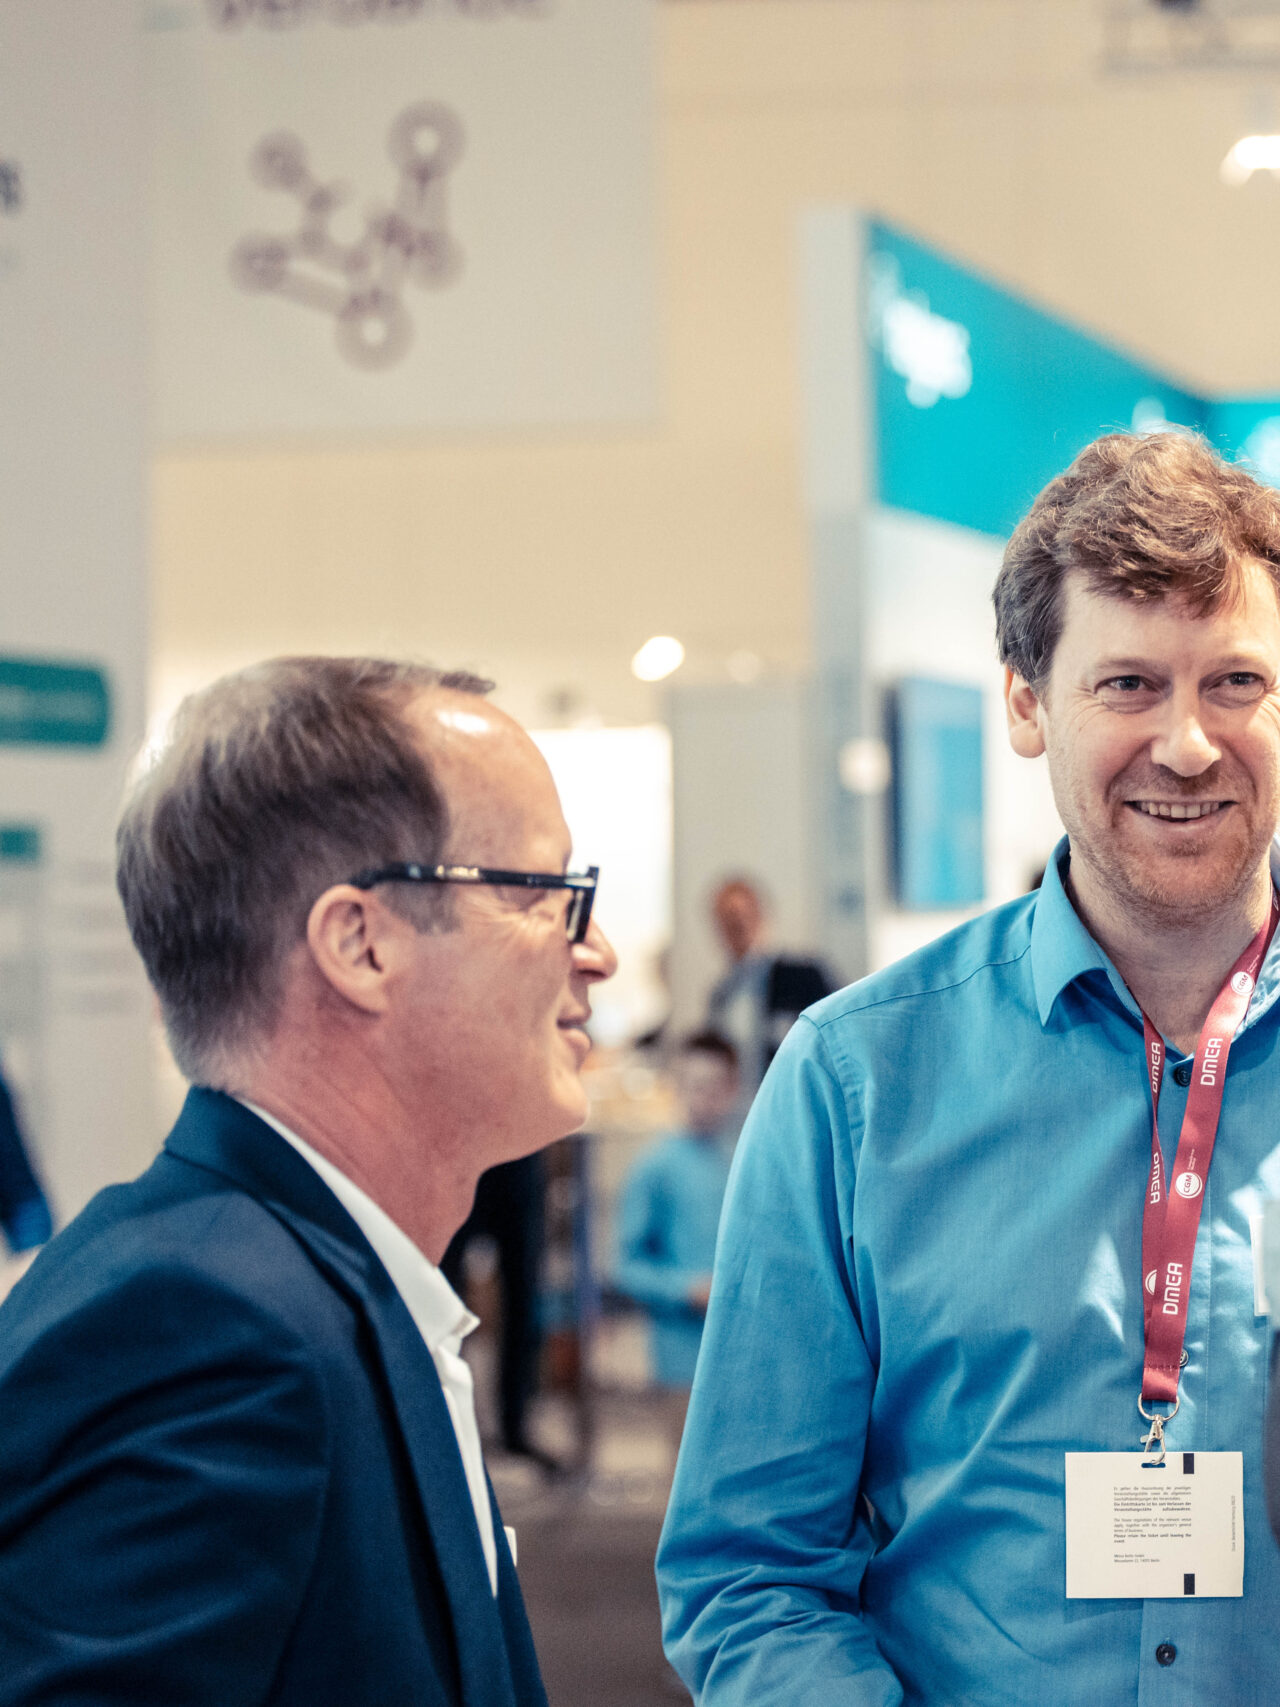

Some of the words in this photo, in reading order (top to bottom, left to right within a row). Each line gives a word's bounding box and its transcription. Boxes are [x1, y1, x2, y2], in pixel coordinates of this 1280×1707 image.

[1150, 1041, 1161, 1094] DMEA
[1199, 1037, 1224, 1086] DMEA
[1149, 1152, 1161, 1204] DMEA
[1183, 1174, 1193, 1194] CGM
[1162, 1262, 1183, 1316] DMEA
